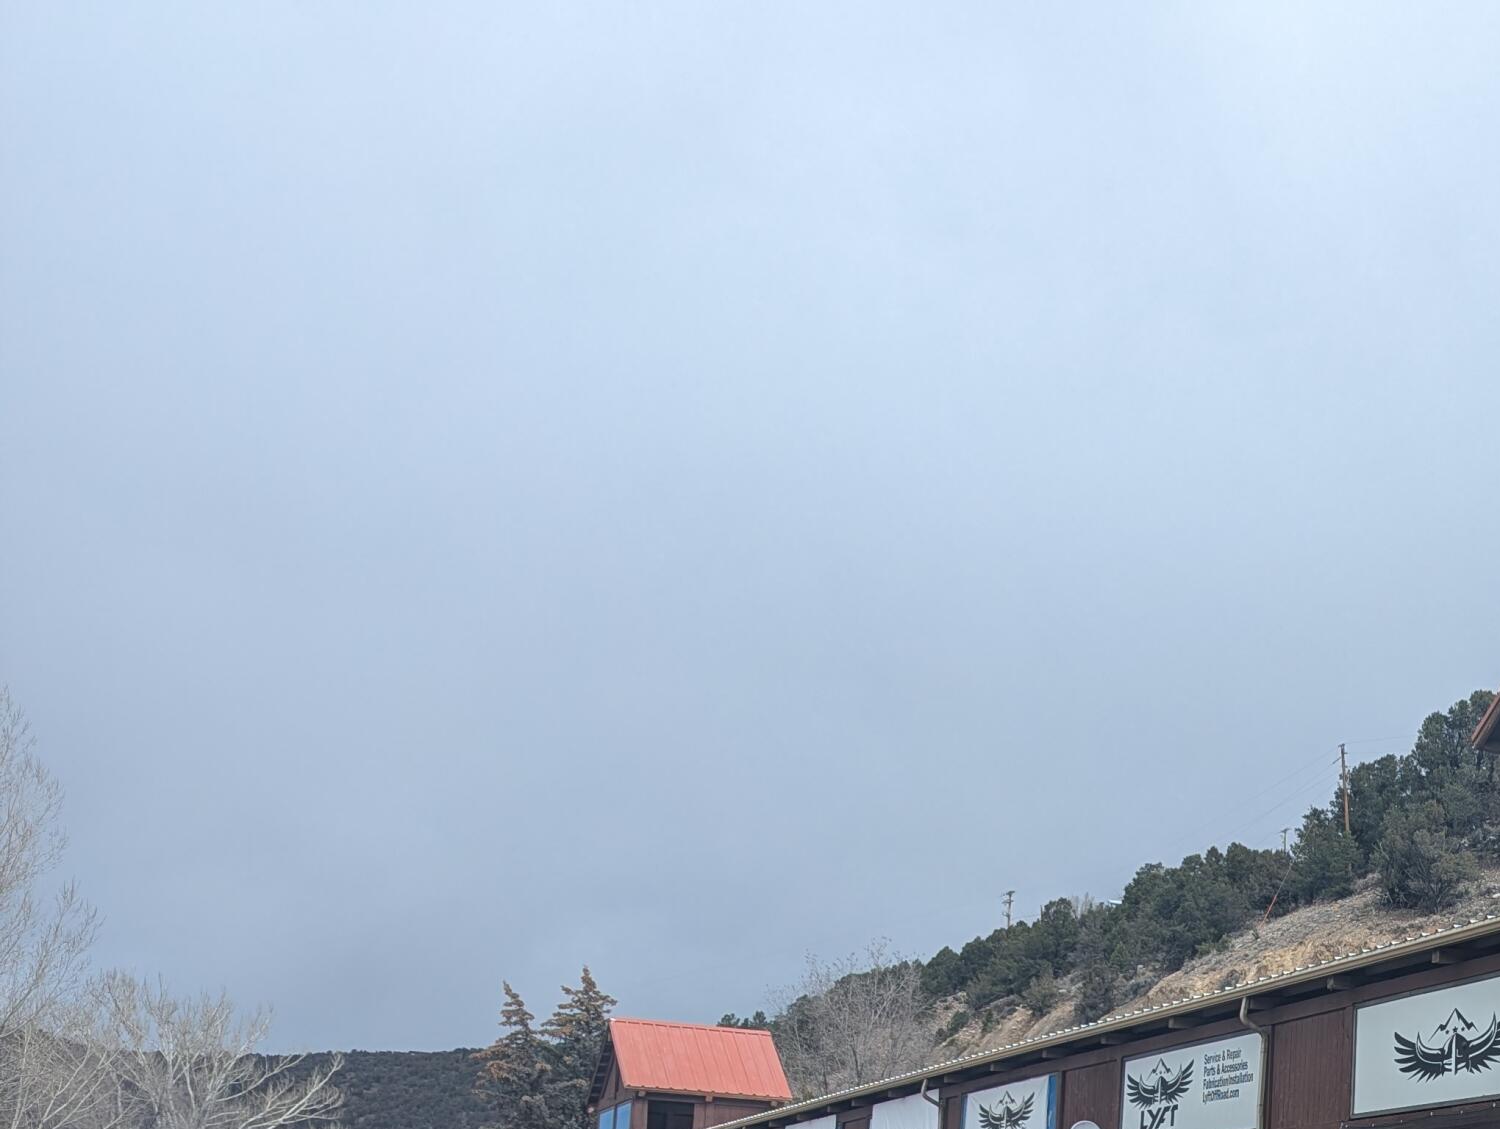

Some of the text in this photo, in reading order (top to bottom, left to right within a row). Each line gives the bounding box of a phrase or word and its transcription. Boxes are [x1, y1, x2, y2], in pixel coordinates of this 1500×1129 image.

[1204, 1048, 1242, 1065] Service & Repair
[1203, 1060, 1248, 1077] Parts & Accessories
